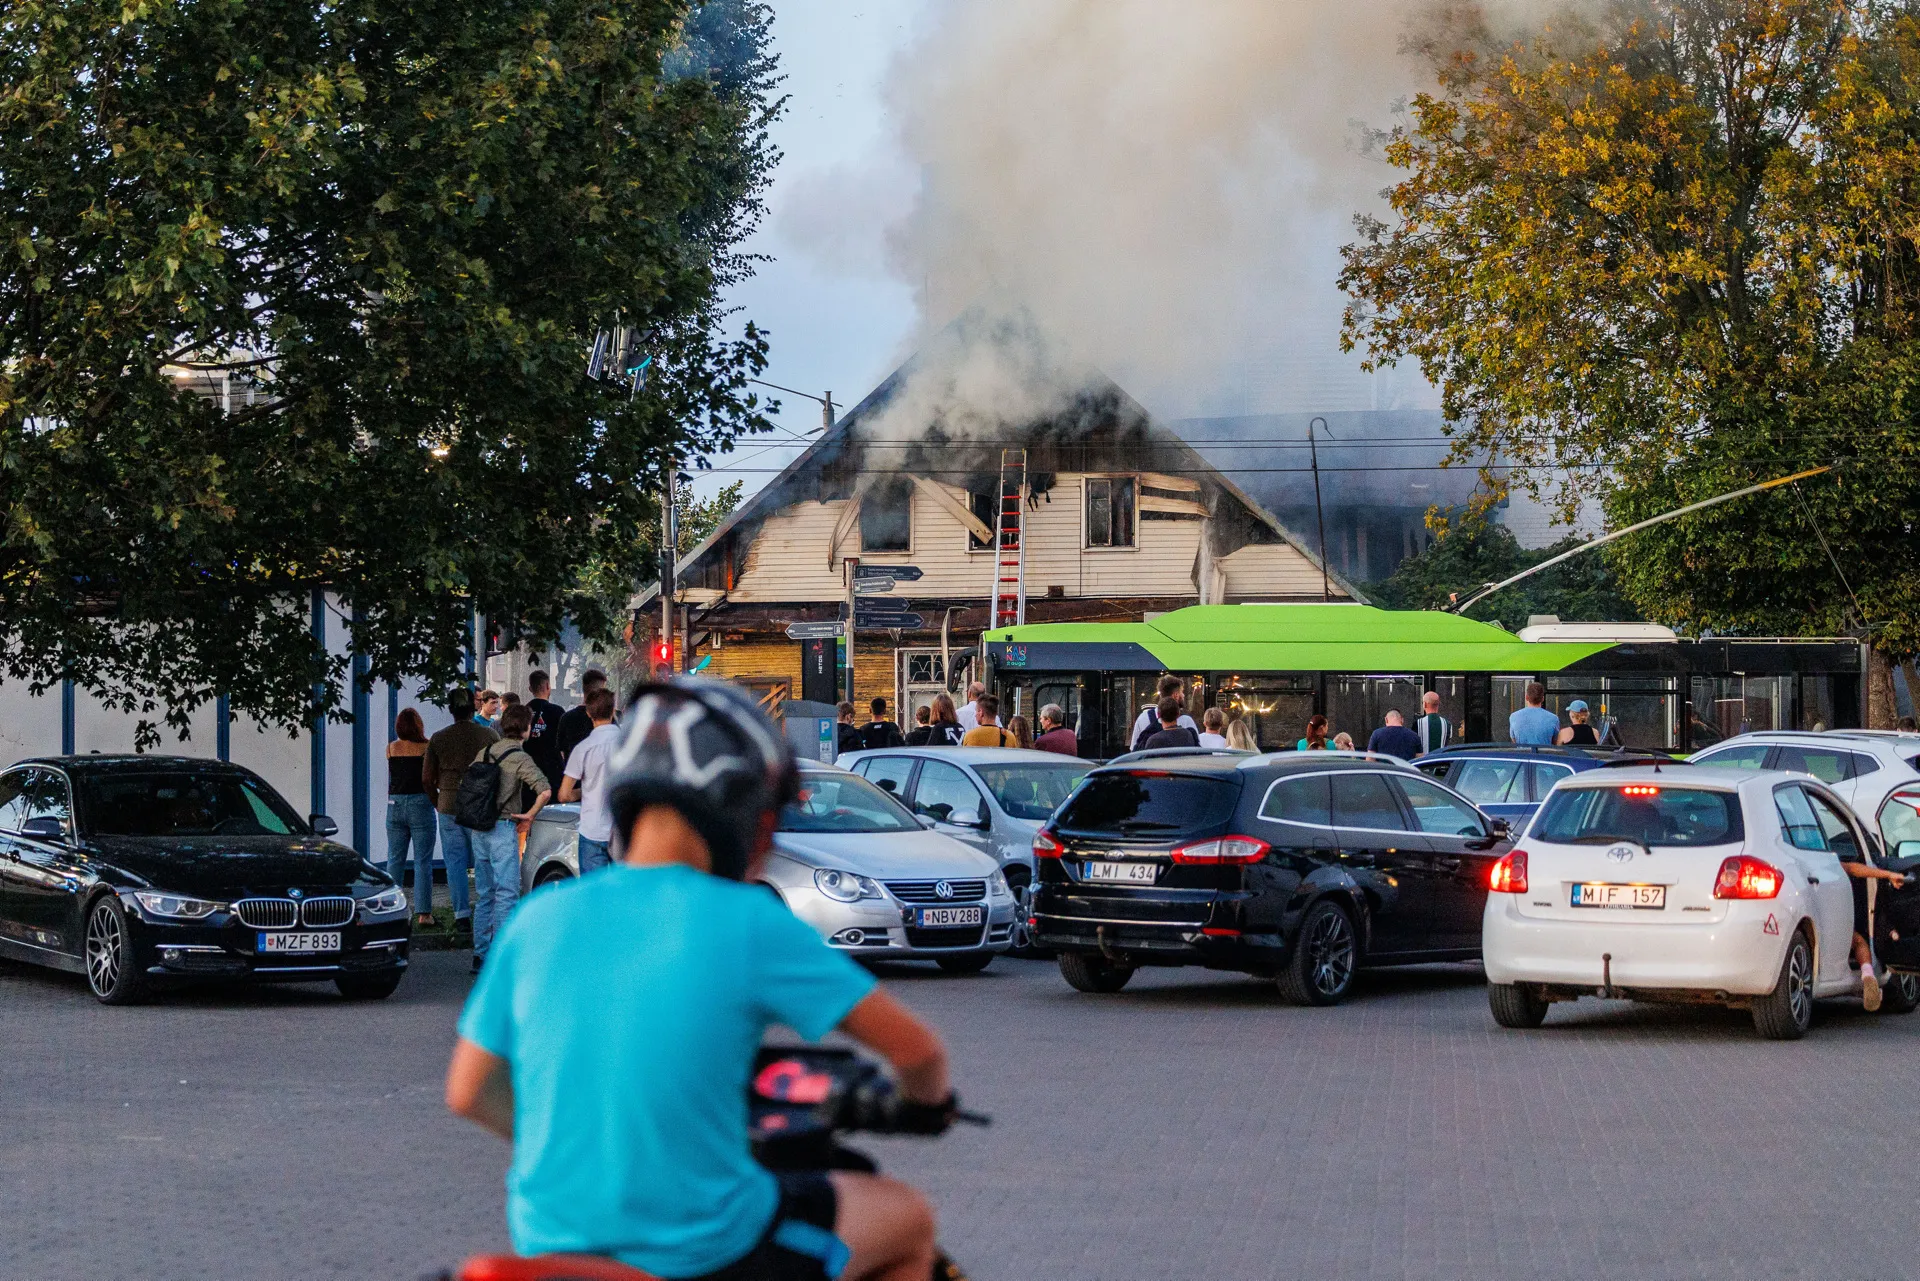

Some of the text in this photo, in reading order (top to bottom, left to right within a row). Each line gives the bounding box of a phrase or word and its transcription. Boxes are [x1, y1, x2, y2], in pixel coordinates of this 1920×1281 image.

[821, 721, 830, 734] P
[1092, 864, 1153, 879] LMI 434
[1583, 887, 1660, 903] MIF 157
[932, 910, 957, 923] NBV
[960, 909, 979, 922] 288
[276, 934, 338, 949] MZF 893
